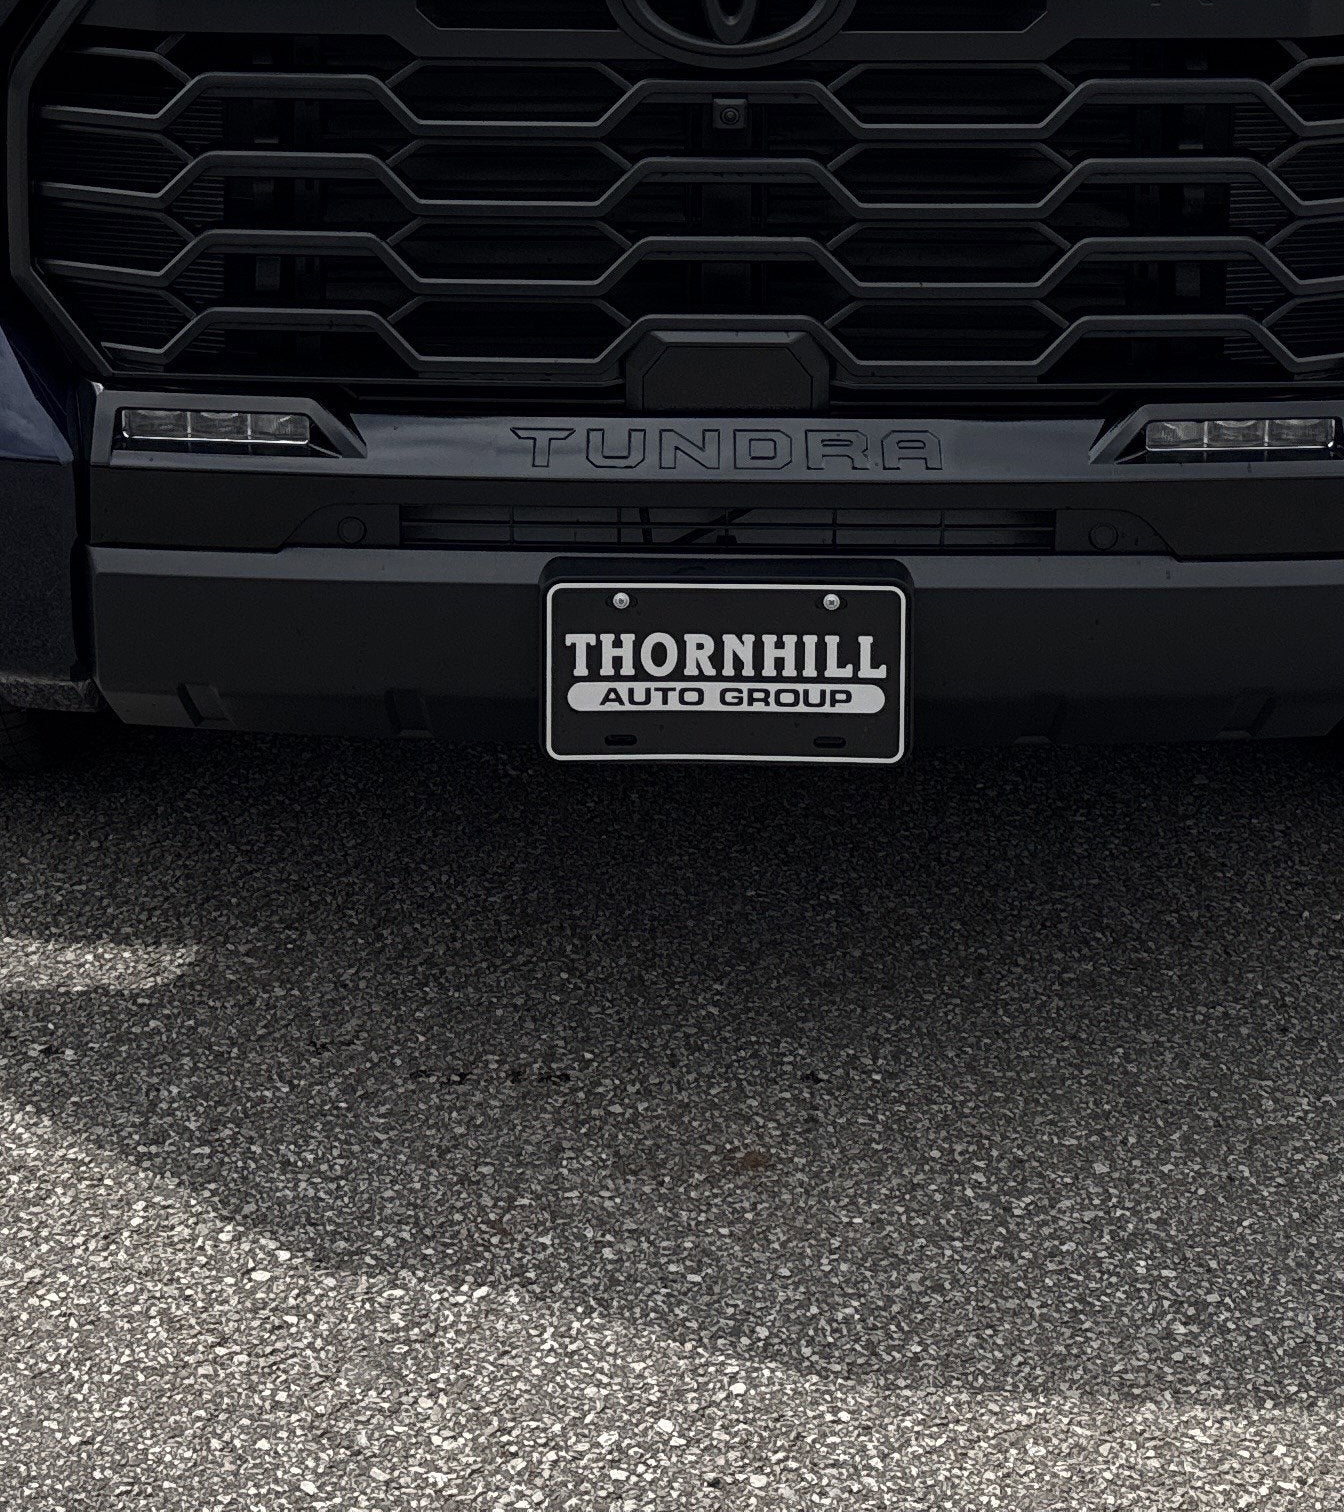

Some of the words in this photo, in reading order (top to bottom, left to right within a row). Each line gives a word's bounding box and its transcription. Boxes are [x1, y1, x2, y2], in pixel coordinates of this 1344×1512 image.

[510, 427, 945, 471] TUNDRA
[565, 632, 887, 679] THORNHILL
[599, 687, 705, 707] AUTO
[719, 687, 853, 709] GROUP
